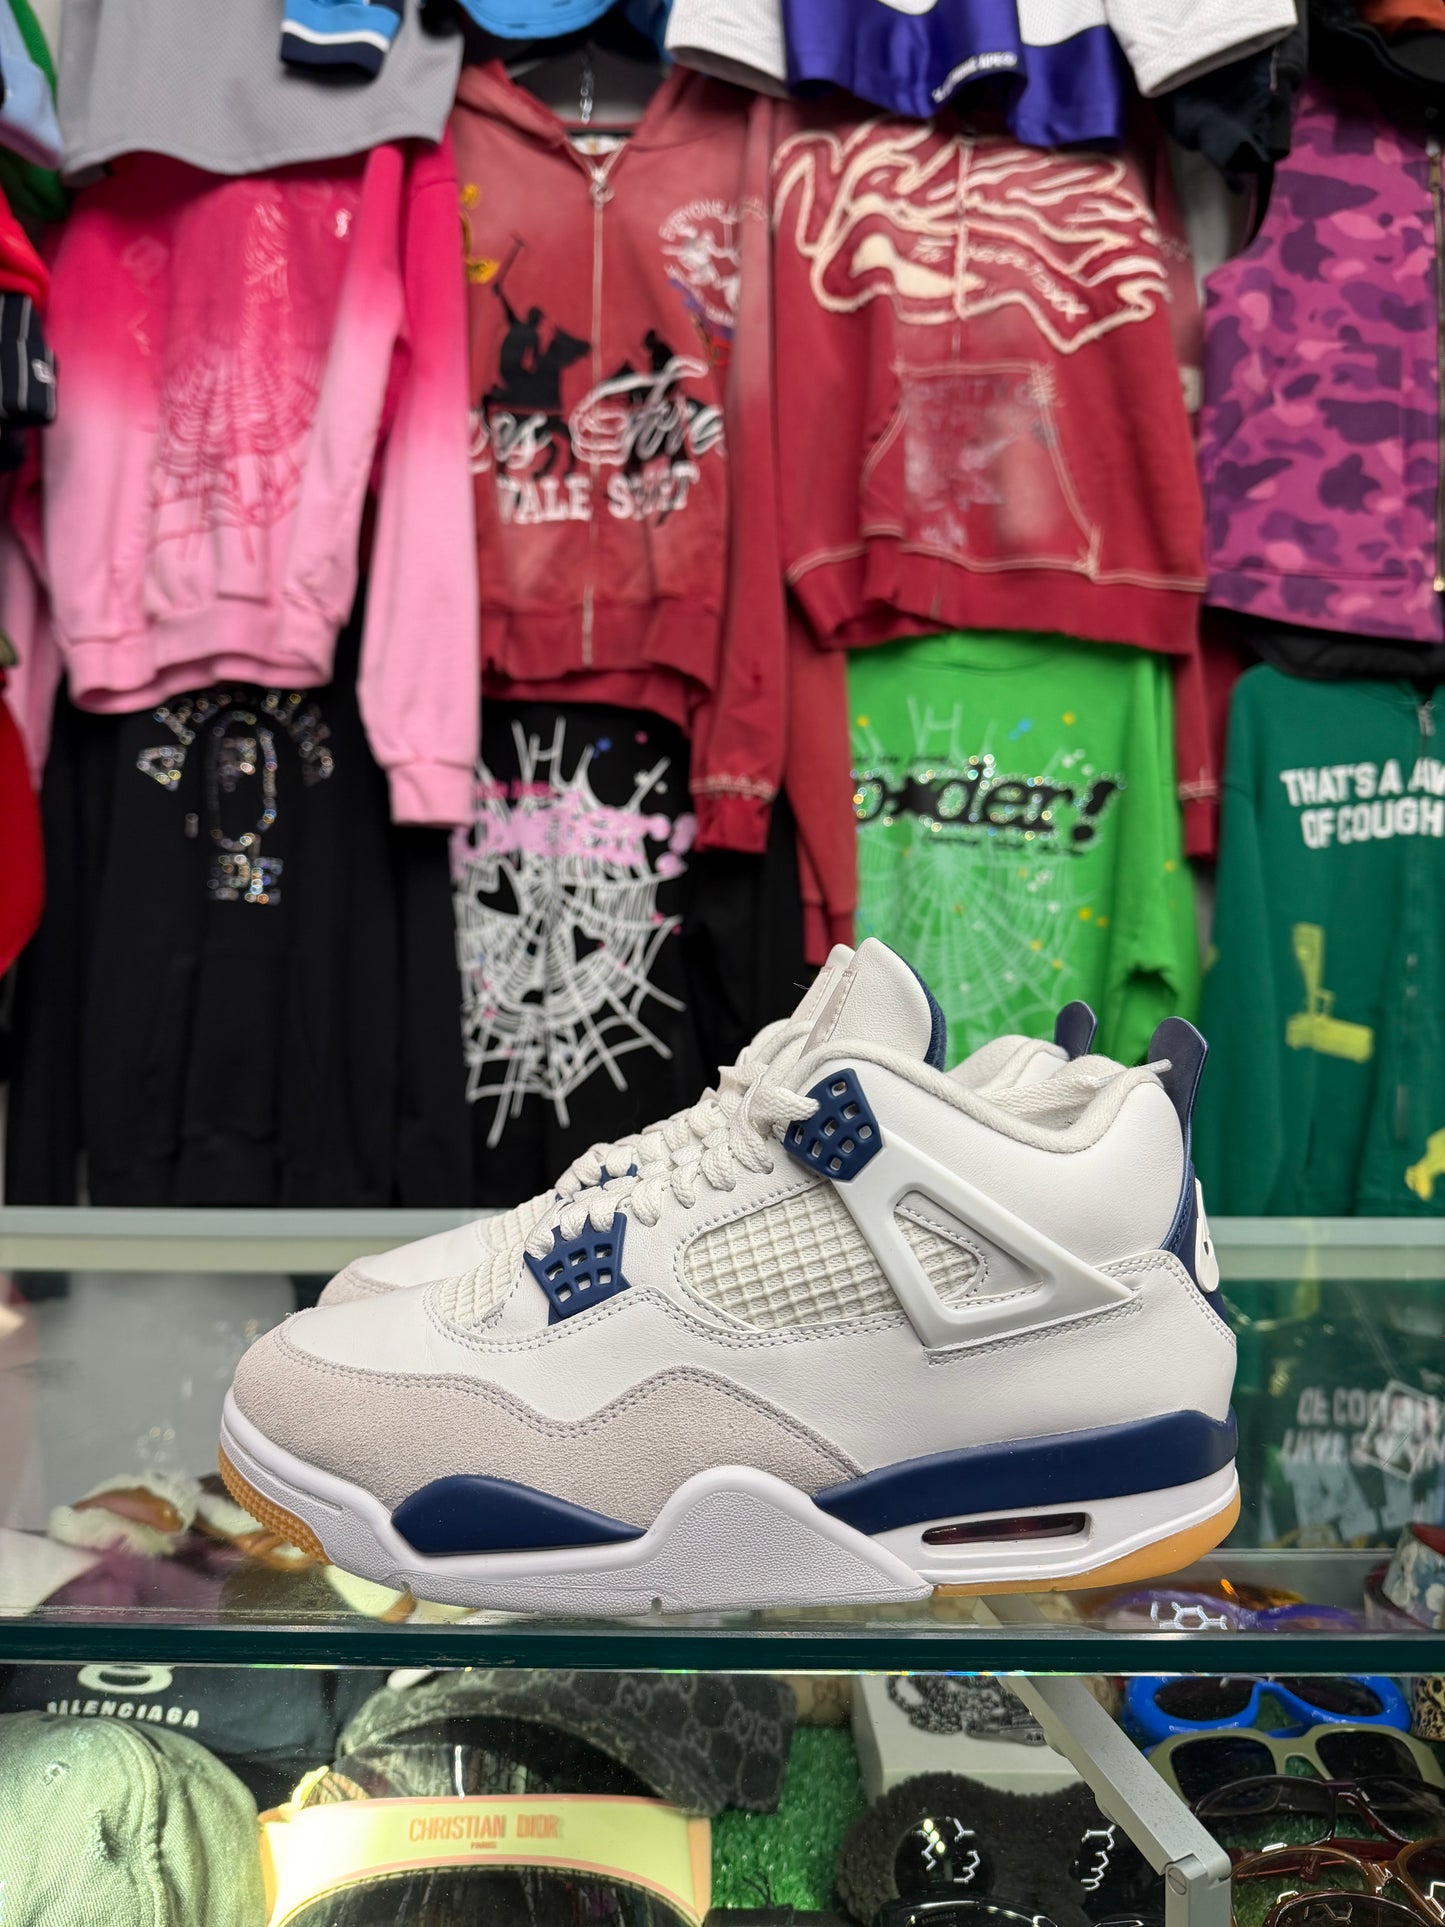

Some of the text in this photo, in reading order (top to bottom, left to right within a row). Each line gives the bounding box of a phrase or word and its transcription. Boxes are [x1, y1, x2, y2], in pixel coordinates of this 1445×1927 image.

[1280, 761, 1378, 807] THAT'S
[1378, 758, 1402, 796] A
[1301, 796, 1444, 849] OF COUGH
[409, 1813, 561, 1842] CHRISTIAN DIOR
